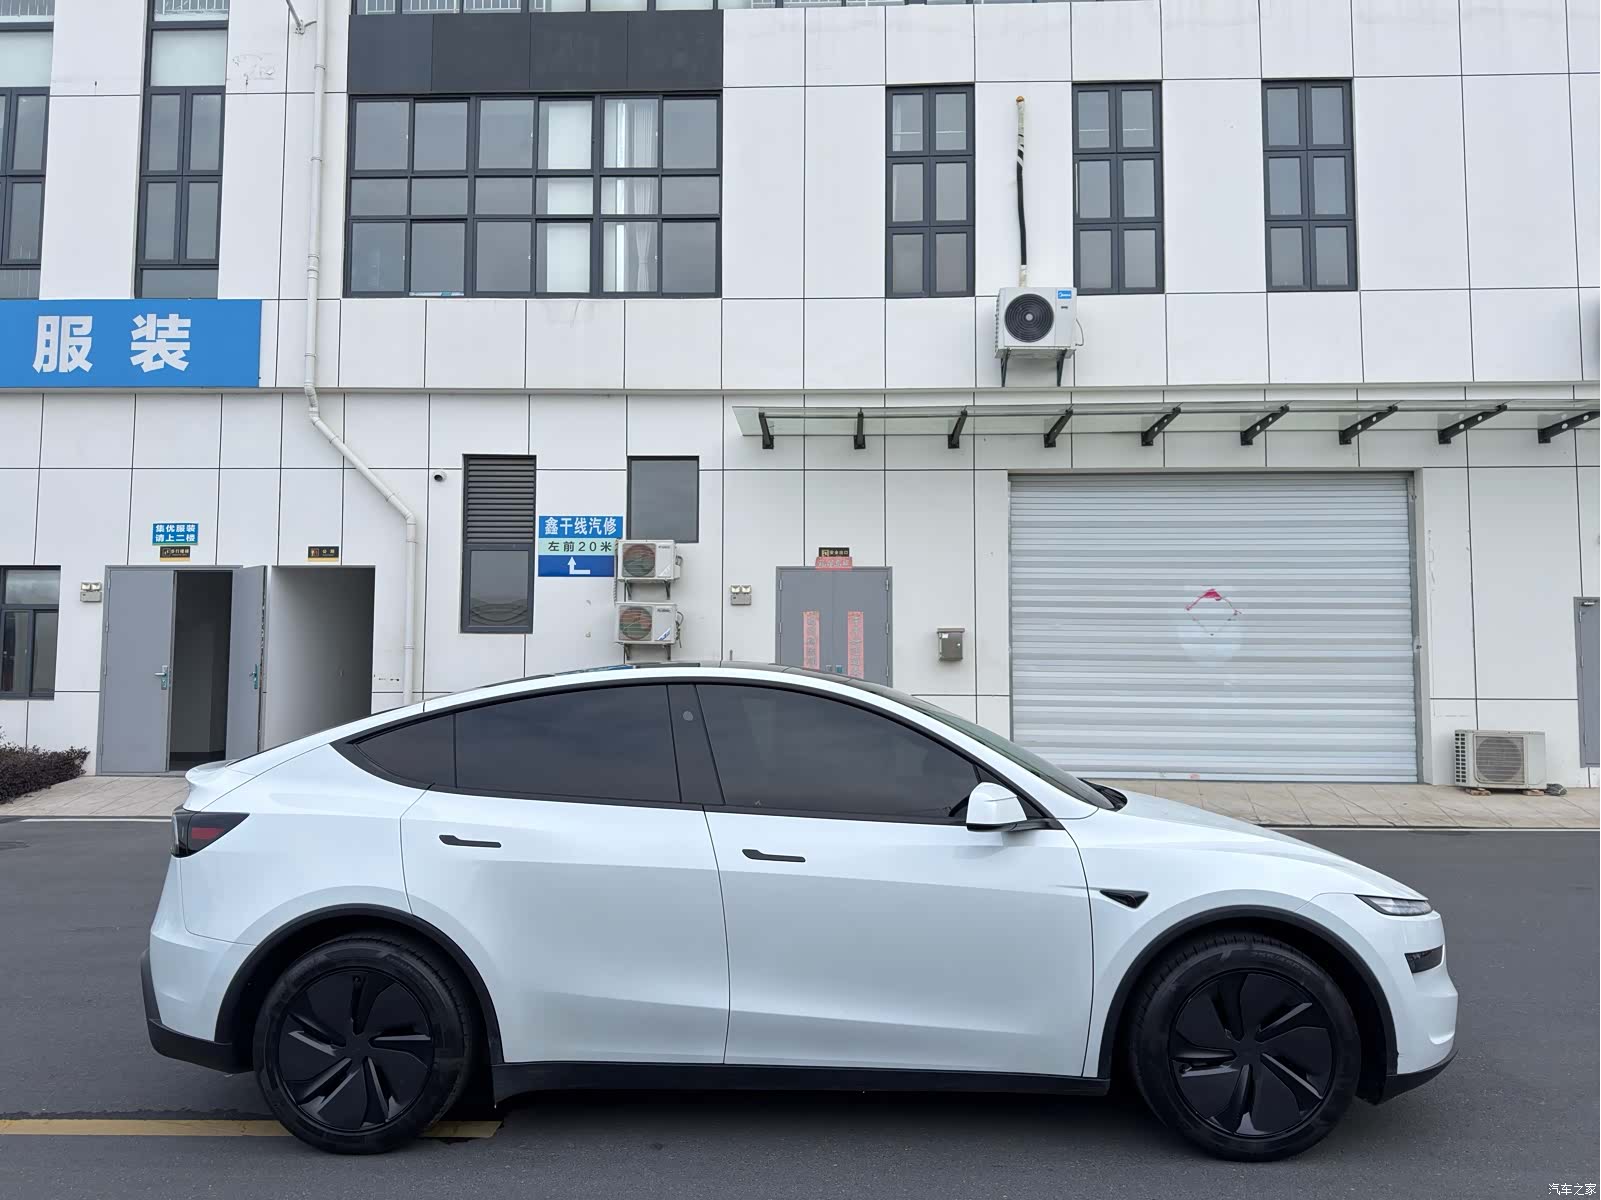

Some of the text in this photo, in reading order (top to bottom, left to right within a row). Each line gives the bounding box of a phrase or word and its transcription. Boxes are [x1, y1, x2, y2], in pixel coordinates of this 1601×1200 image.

[32, 313, 192, 373] 服装
[155, 524, 196, 533] 集优服装
[544, 516, 617, 535] 鑫干线汽修
[155, 533, 196, 542] 请上二楼
[548, 541, 612, 552] 左前20米
